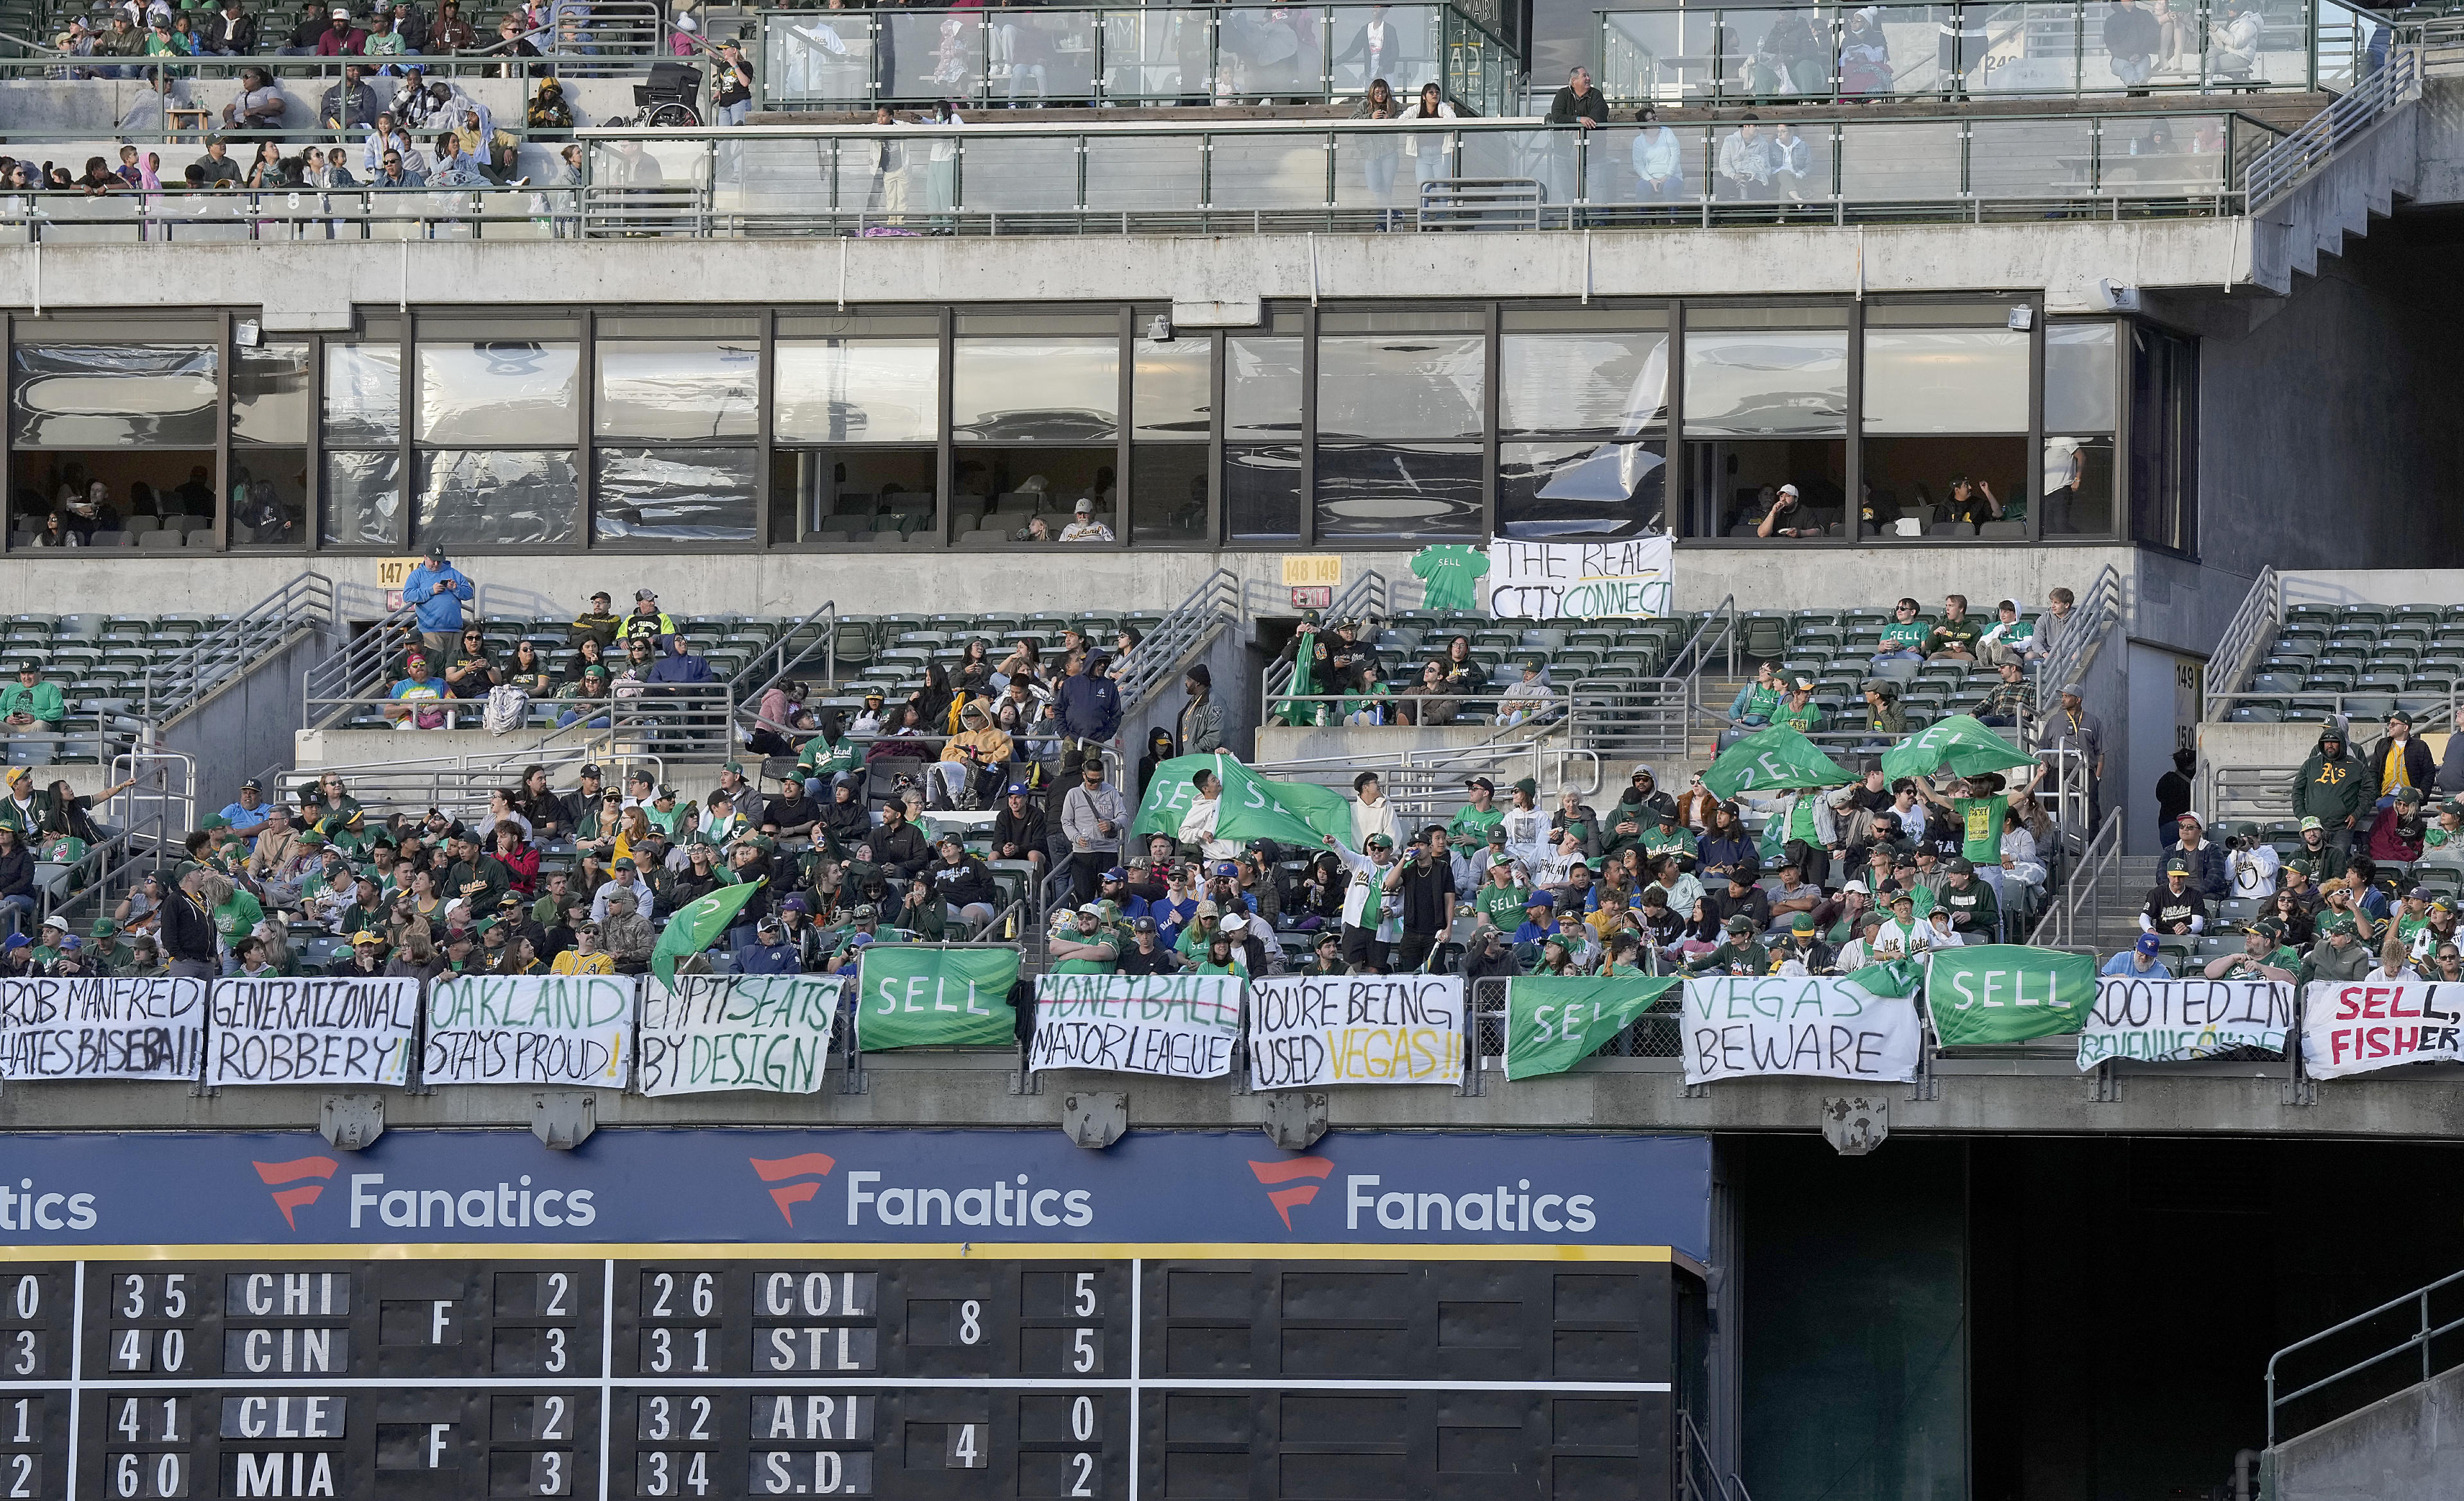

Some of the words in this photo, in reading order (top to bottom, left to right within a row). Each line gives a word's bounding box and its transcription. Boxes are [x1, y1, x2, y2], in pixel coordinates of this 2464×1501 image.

[380, 563, 402, 583] 147
[1285, 560, 1308, 581] 148
[1315, 560, 1339, 581] 149
[1438, 558, 1461, 567] SELL
[1494, 542, 1566, 578] THE
[1582, 542, 1659, 577] REAL
[1297, 588, 1325, 606] EXIT
[1491, 585, 1566, 619] CITY
[1563, 581, 1671, 619] CONNECT
[1890, 630, 1920, 640] SELL
[2177, 664, 2194, 689] 149
[2177, 725, 2194, 750] 150
[1469, 821, 1488, 832] ELL
[1537, 859, 1568, 881] OAKLAN
[1159, 918, 1173, 931] BLU
[1489, 895, 1522, 913] SELL
[1191, 941, 1210, 950] SEL
[3, 980, 60, 1027] ROB
[65, 977, 199, 1022] MANFRED
[212, 980, 412, 1031] GENERATIONAL
[431, 977, 625, 1027] OAKLAND
[727, 978, 837, 1031] SEATS
[877, 975, 989, 1016] SELL
[1038, 975, 1239, 1027] MONEYBALL
[1253, 979, 1337, 1034] YOU'RE
[1347, 981, 1452, 1029] BEING
[1689, 977, 1863, 1022] VEGAS
[1953, 970, 2071, 1010] SELL
[2228, 982, 2291, 1027] IN
[2336, 984, 2461, 1025] SELL,
[0, 1029, 73, 1076] HATES
[429, 1030, 510, 1079] STAYS
[516, 1031, 621, 1083] PROUD!
[644, 1034, 686, 1091] BY
[691, 1033, 818, 1091] DESIGN
[1031, 1022, 1118, 1070] MAJOR
[1126, 1029, 1226, 1074] LEAGUE
[1255, 1034, 1324, 1085] USED
[1326, 1028, 1461, 1079] VEGAS!!
[1695, 1024, 1885, 1075] BEWARE
[2331, 1025, 2460, 1065] FISHER
[351, 1174, 595, 1228] Fanatics
[848, 1171, 1092, 1226] Fanatics
[1348, 1175, 1595, 1231] Fanatics
[17, 1276, 38, 1319] 0
[124, 1274, 185, 1318] 35
[246, 1274, 331, 1315] CHI
[547, 1273, 567, 1315] 2
[653, 1273, 712, 1316] 26
[767, 1273, 864, 1316] COL
[1075, 1273, 1095, 1316] 5
[433, 1301, 452, 1343] F
[961, 1301, 980, 1344] 8
[15, 1331, 35, 1374] 3
[119, 1330, 184, 1371] 40
[245, 1329, 329, 1372] CIN
[546, 1328, 565, 1371] 3
[652, 1328, 708, 1372] 31
[771, 1328, 859, 1370] STL
[1074, 1328, 1093, 1372] 5
[14, 1399, 30, 1442] 1
[119, 1398, 178, 1441] 41
[240, 1397, 329, 1437] CLE
[543, 1396, 563, 1439] 2
[650, 1396, 710, 1439] 32
[770, 1396, 856, 1439] ARI
[1072, 1396, 1093, 1441] 0
[430, 1425, 449, 1468] F
[956, 1425, 977, 1467] 4
[11, 1455, 31, 1497] 2
[118, 1454, 178, 1497] 60
[237, 1453, 334, 1497] MIA
[540, 1452, 560, 1495] 3
[648, 1452, 708, 1495] 34
[766, 1452, 855, 1493] S.D.
[1072, 1453, 1092, 1496] 2
